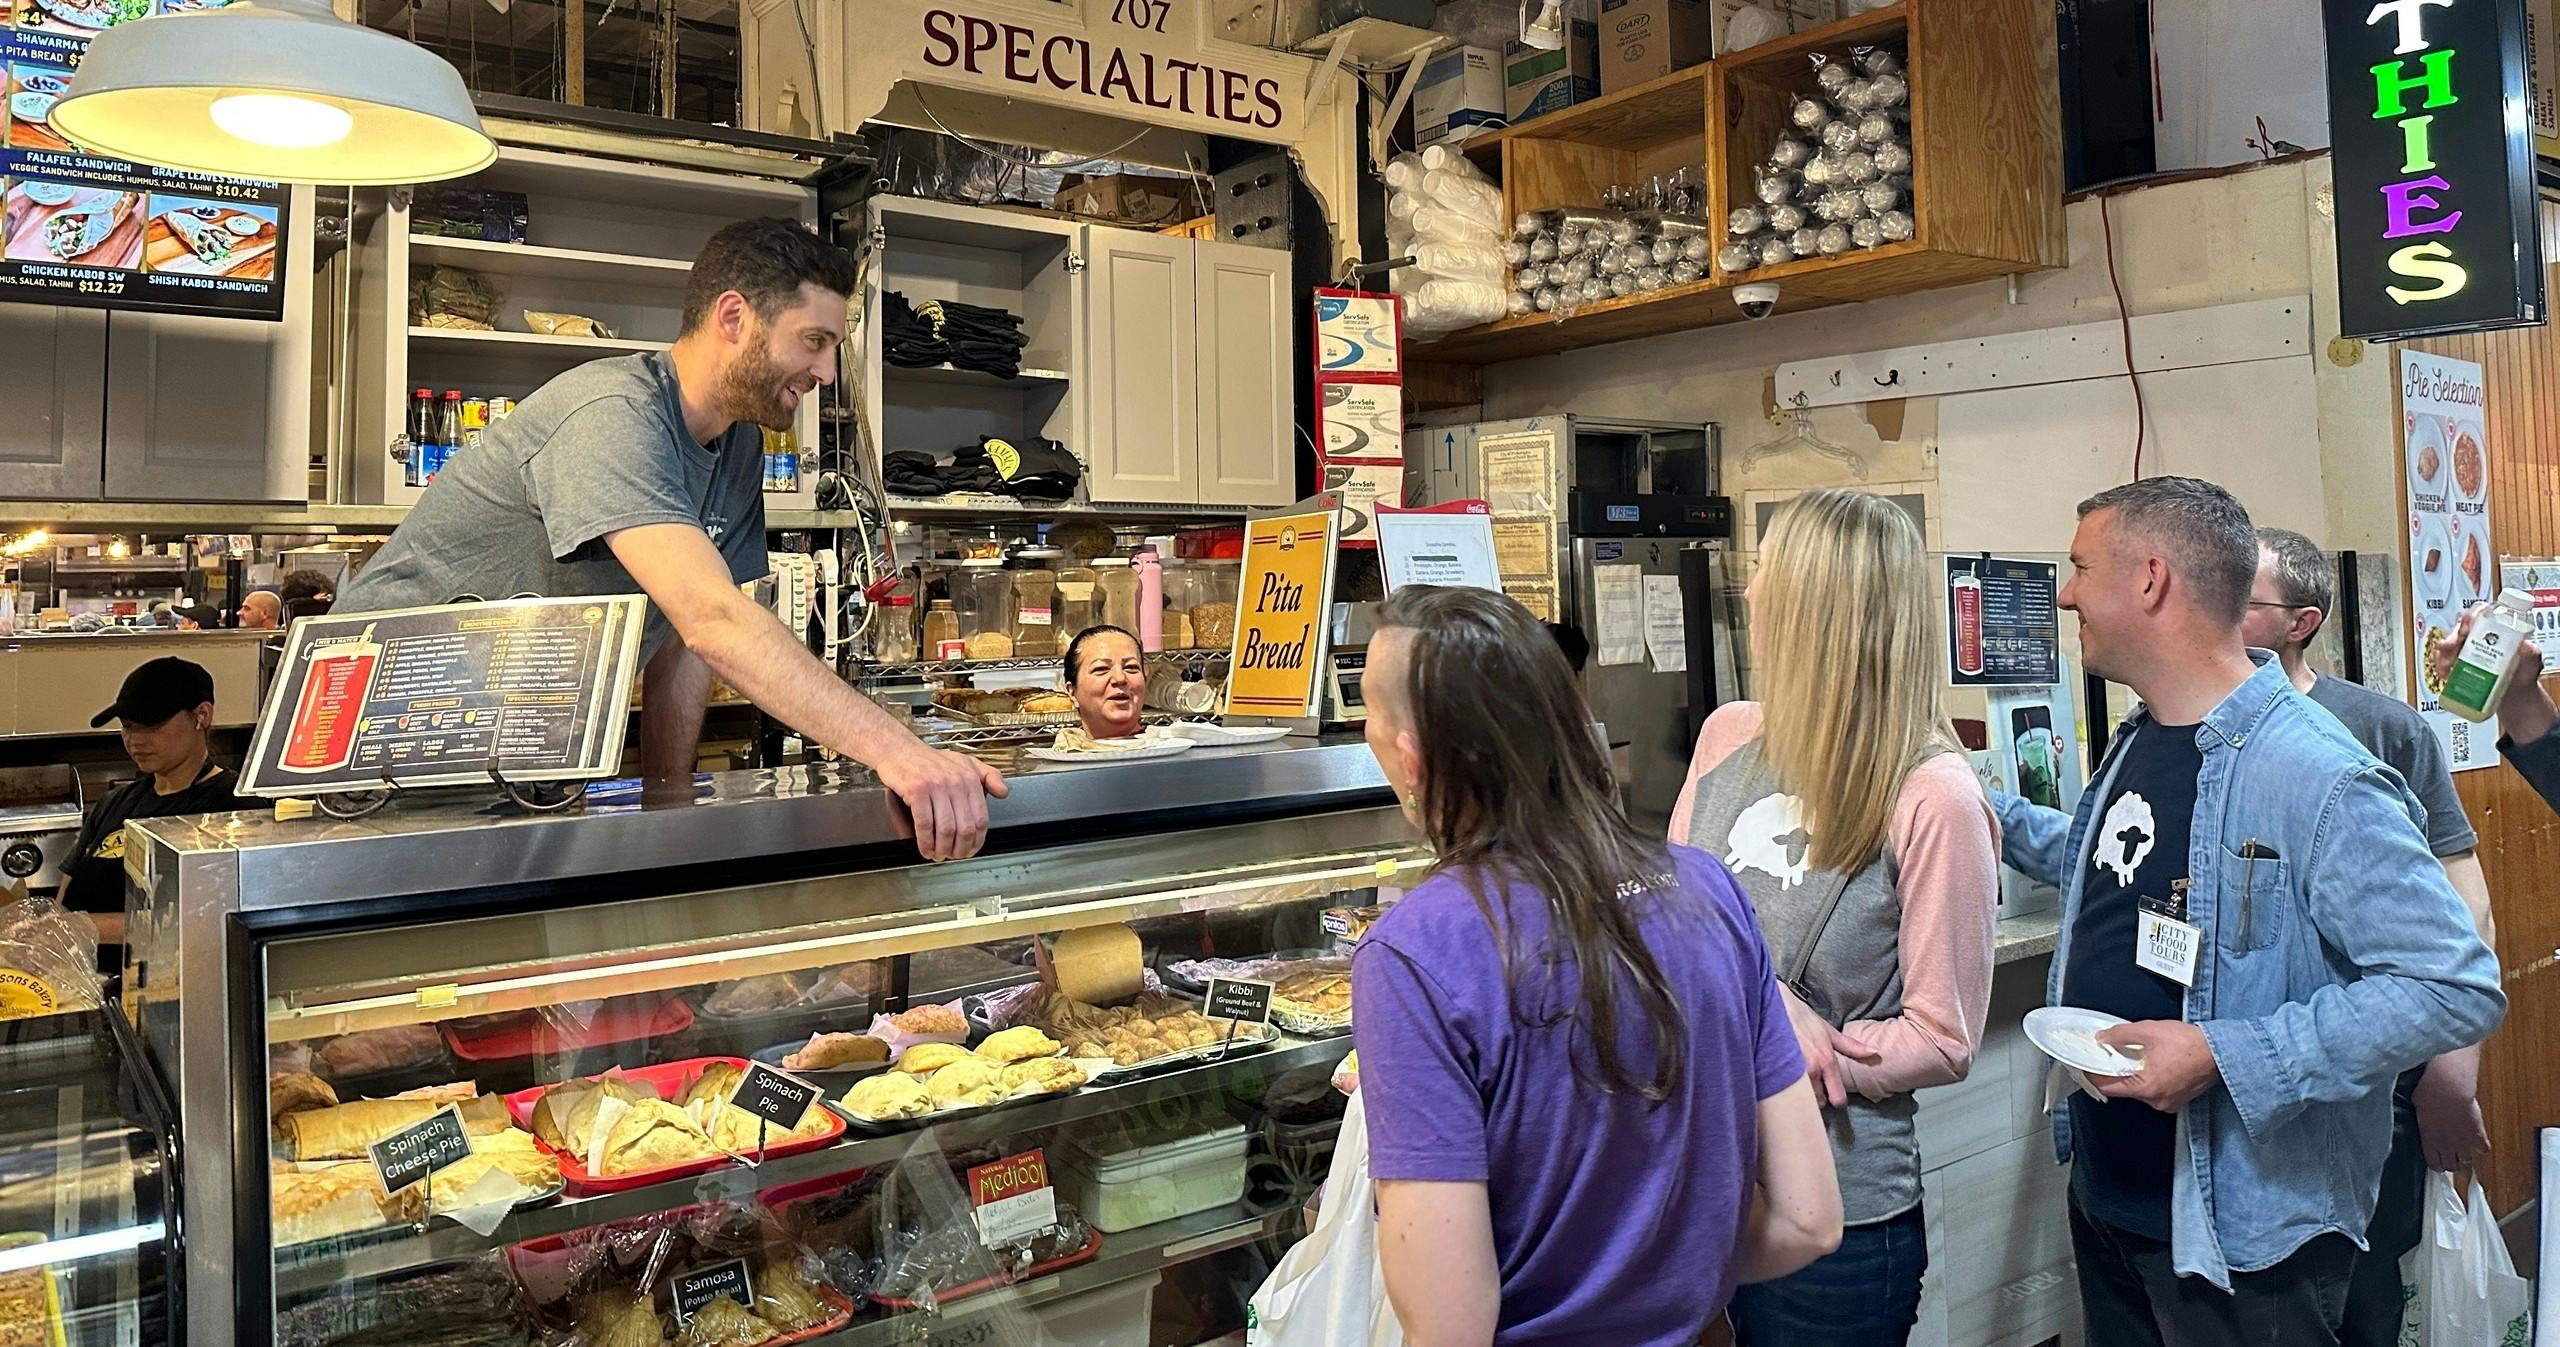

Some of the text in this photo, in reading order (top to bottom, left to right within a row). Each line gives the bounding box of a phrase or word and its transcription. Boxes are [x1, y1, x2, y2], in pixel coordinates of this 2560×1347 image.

[1620, 16, 1646, 30] DART
[16, 32, 91, 52] SHAWARMA G
[6, 45, 28, 58] PITA
[31, 49, 64, 63] BREAD
[923, 9, 1282, 129] SPECIALTIES
[26, 152, 132, 173] FALAFEL SANDWICH
[9, 162, 39, 173] VEGGIE
[40, 166, 83, 178] SANDWICH
[162, 179, 187, 190] SALAD,
[189, 182, 212, 192] TAHINI
[215, 184, 259, 199] $10.42
[151, 166, 278, 190] GRAPE LEAVES SANDWICH
[21, 264, 126, 282] CHICKEN KABOB SW
[19, 277, 46, 287] SALAD,
[49, 279, 73, 288] TAHINI
[79, 280, 125, 294] $12.27
[148, 275, 268, 293] SHISH KABOB SANDWICH
[1343, 313, 1370, 321] ServSafe
[2406, 362, 2483, 407] Pie Selection
[1347, 398, 1375, 406] ServSafe
[1348, 480, 1376, 488] ServSafe
[2456, 502, 2484, 513] MEAT PIE
[1255, 571, 1304, 613] Pita
[2426, 599, 2444, 609] KIBBI
[1240, 623, 1311, 670] Bread
[2162, 924, 2186, 941] CITY
[2150, 941, 2186, 962] TOURS
[2161, 935, 2186, 952] FOOD
[29, 981, 52, 1007] Bakery
[1229, 984, 1253, 996] Kibbi
[1216, 996, 1240, 1005] (Ground
[1225, 1007, 1249, 1016] Walnut)
[755, 1073, 803, 1102] Spinach
[758, 1096, 779, 1113] Pie
[389, 1121, 445, 1155] Spinach
[385, 1136, 462, 1178] Cheese Pie
[980, 1155, 1035, 1174] NATURAL DATES
[980, 1163, 1045, 1205] Medjool
[685, 1270, 735, 1292] Samosa
[684, 1292, 714, 1309] (Potato
